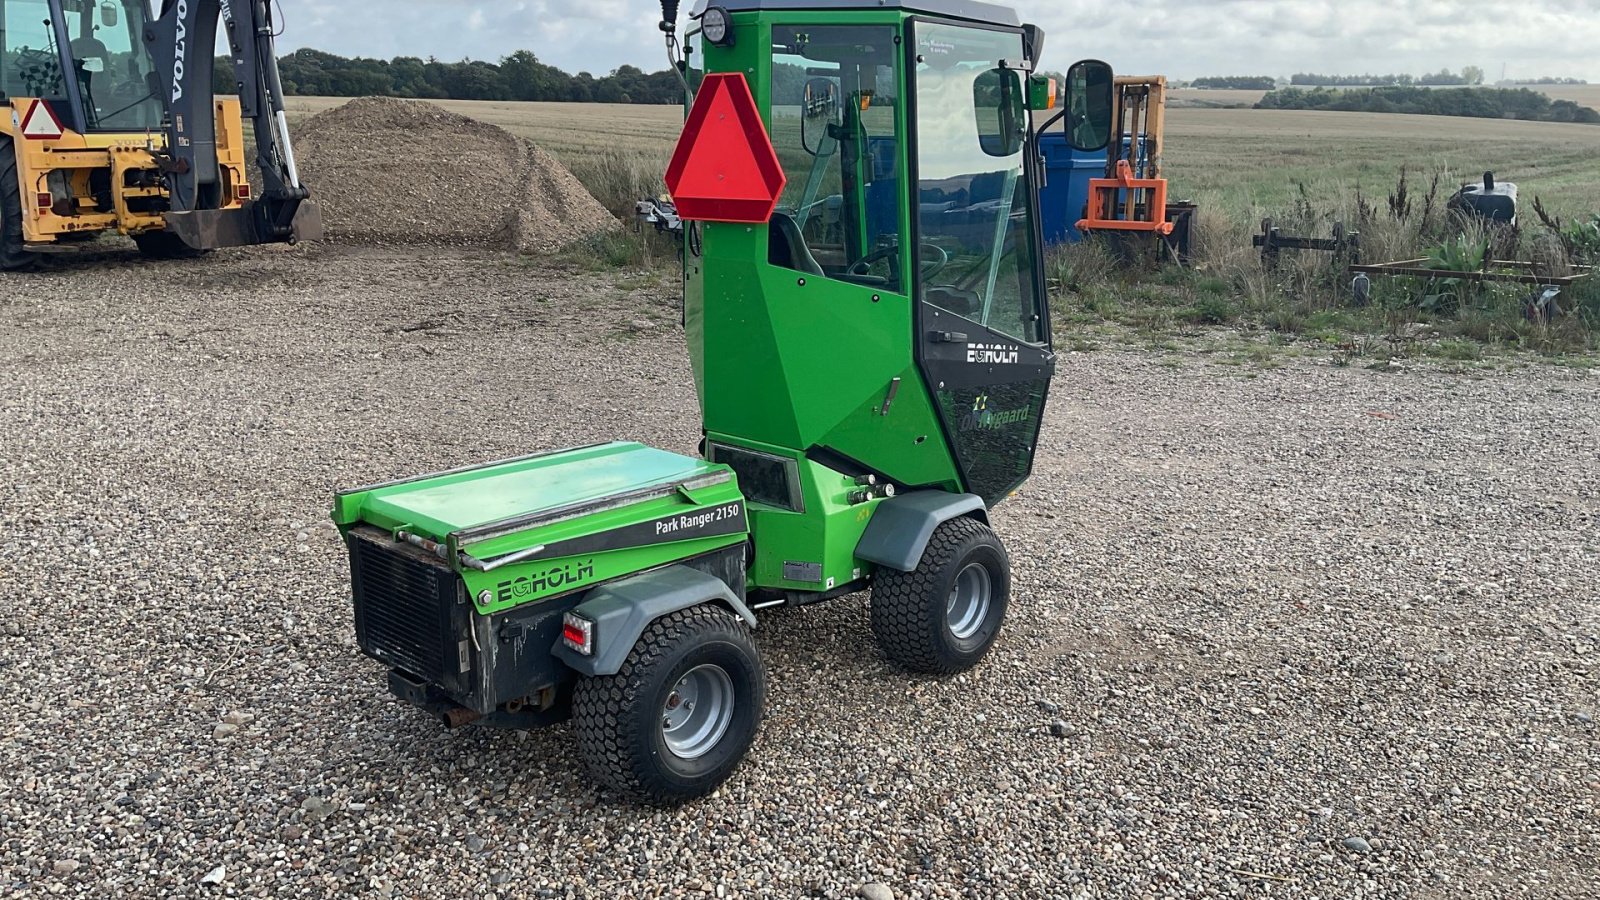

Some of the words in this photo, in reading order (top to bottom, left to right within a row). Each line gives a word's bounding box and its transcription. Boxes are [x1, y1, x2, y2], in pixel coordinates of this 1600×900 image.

[172, 0, 188, 103] VOLVO
[114, 139, 154, 147] VOLV
[967, 343, 1018, 364] EGHOLM
[656, 519, 679, 535] Park
[680, 512, 714, 532] Ranger
[715, 503, 740, 521] 2150
[497, 559, 593, 602] EGHOLM
